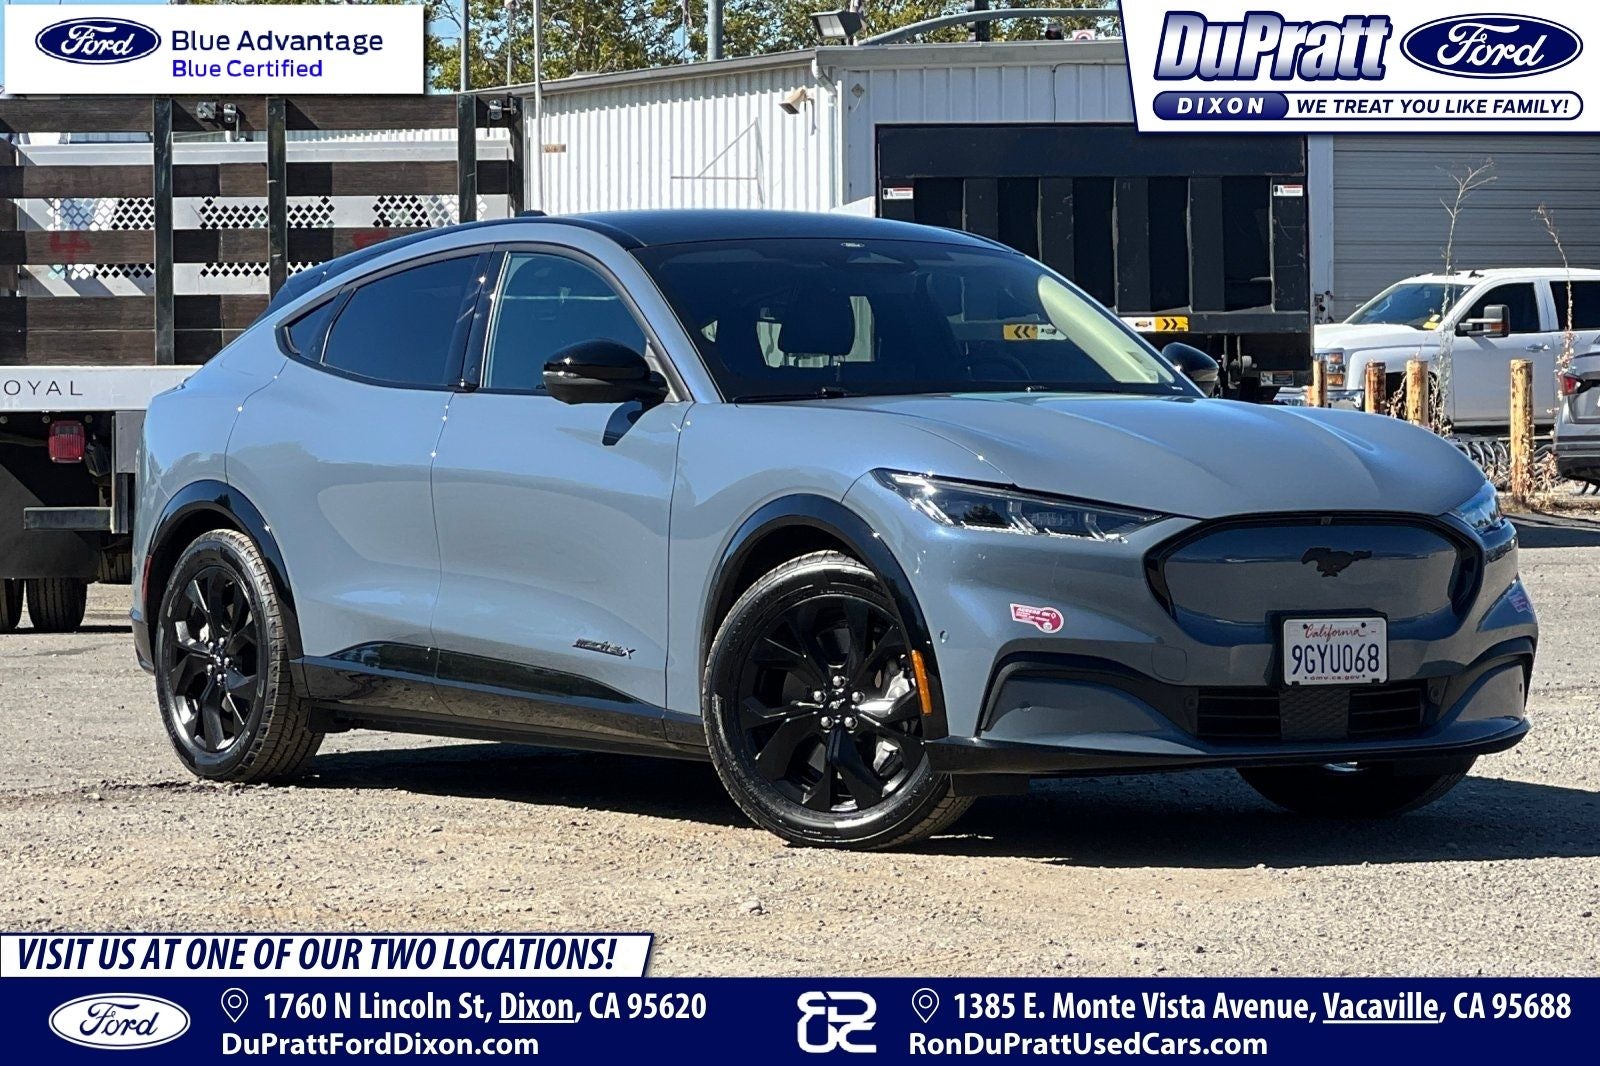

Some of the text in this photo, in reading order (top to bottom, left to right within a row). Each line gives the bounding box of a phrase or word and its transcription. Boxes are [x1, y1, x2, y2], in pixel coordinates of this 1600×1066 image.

[4, 380, 83, 396] OYAL
[1305, 624, 1366, 642] California
[1292, 643, 1380, 675] 9GYU068
